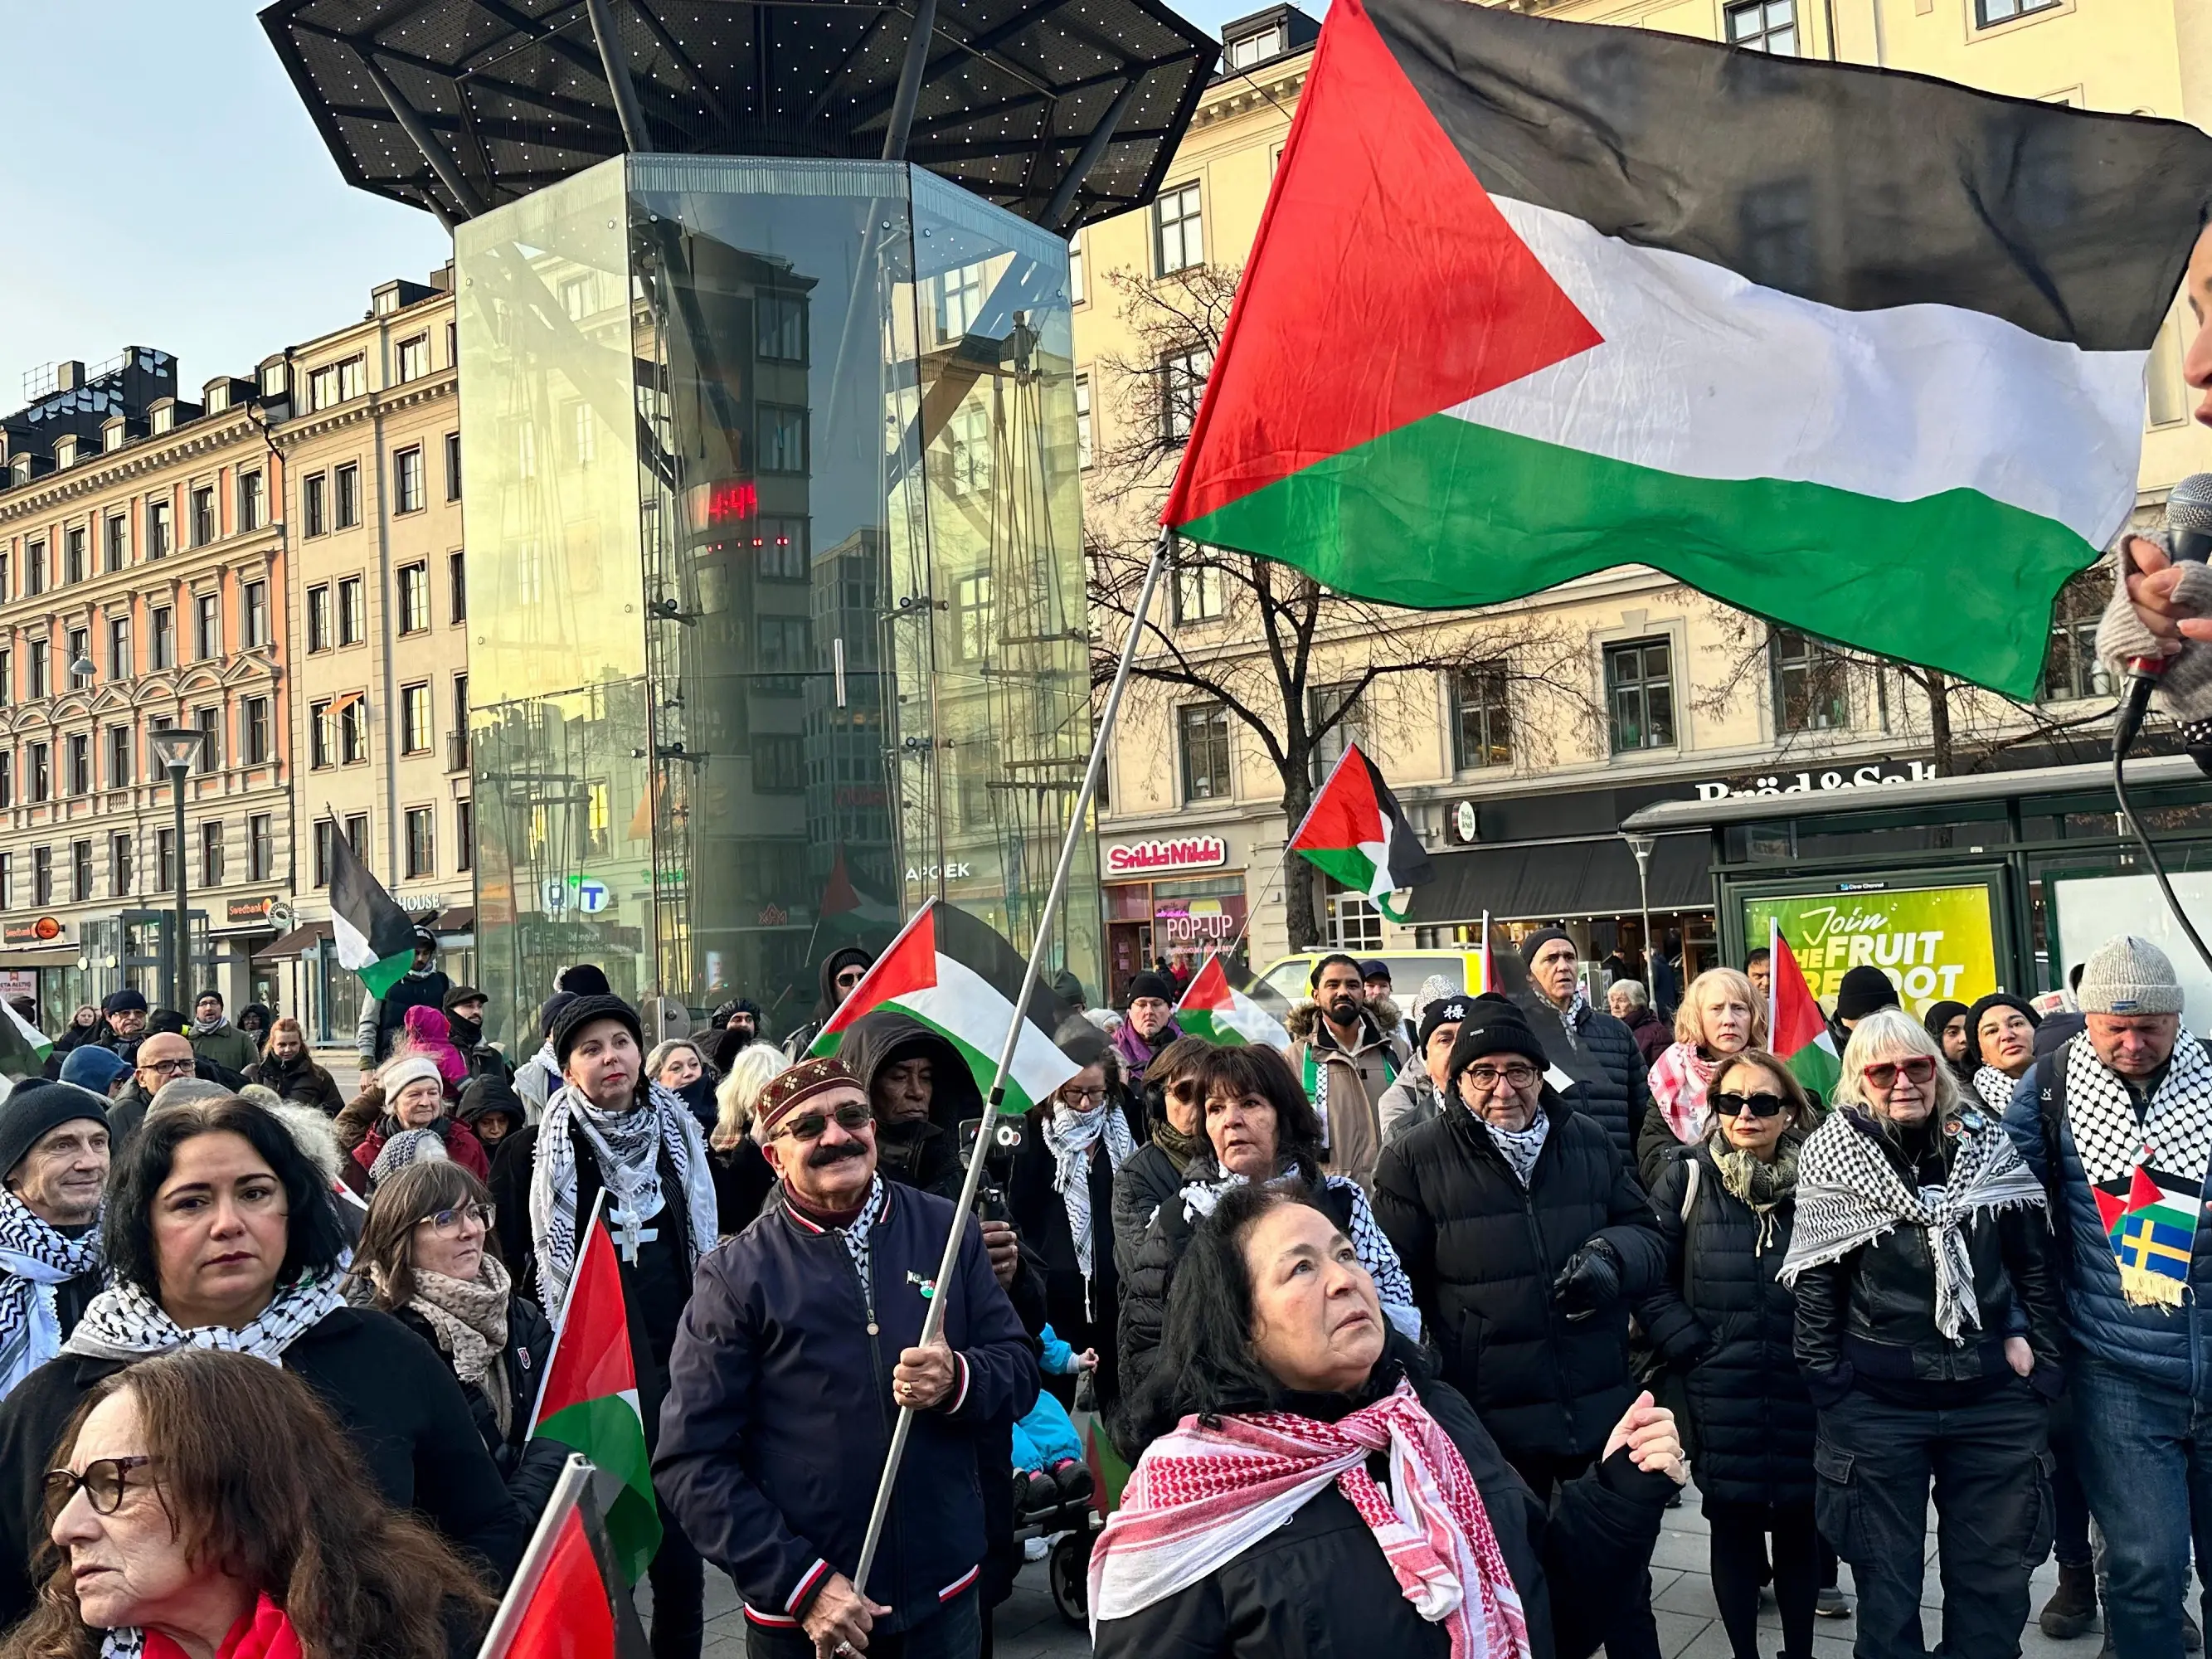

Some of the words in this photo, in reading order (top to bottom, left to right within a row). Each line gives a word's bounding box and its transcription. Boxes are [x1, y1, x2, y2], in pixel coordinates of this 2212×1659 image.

[229, 902, 262, 915] Swedbank
[398, 893, 440, 912] HOUSE
[1166, 914, 1233, 941] POP-UP
[1799, 906, 1889, 946] Join
[1792, 948, 1824, 969] HE
[1825, 930, 1944, 970] FRUIT
[1801, 965, 1965, 1001] REOOT
